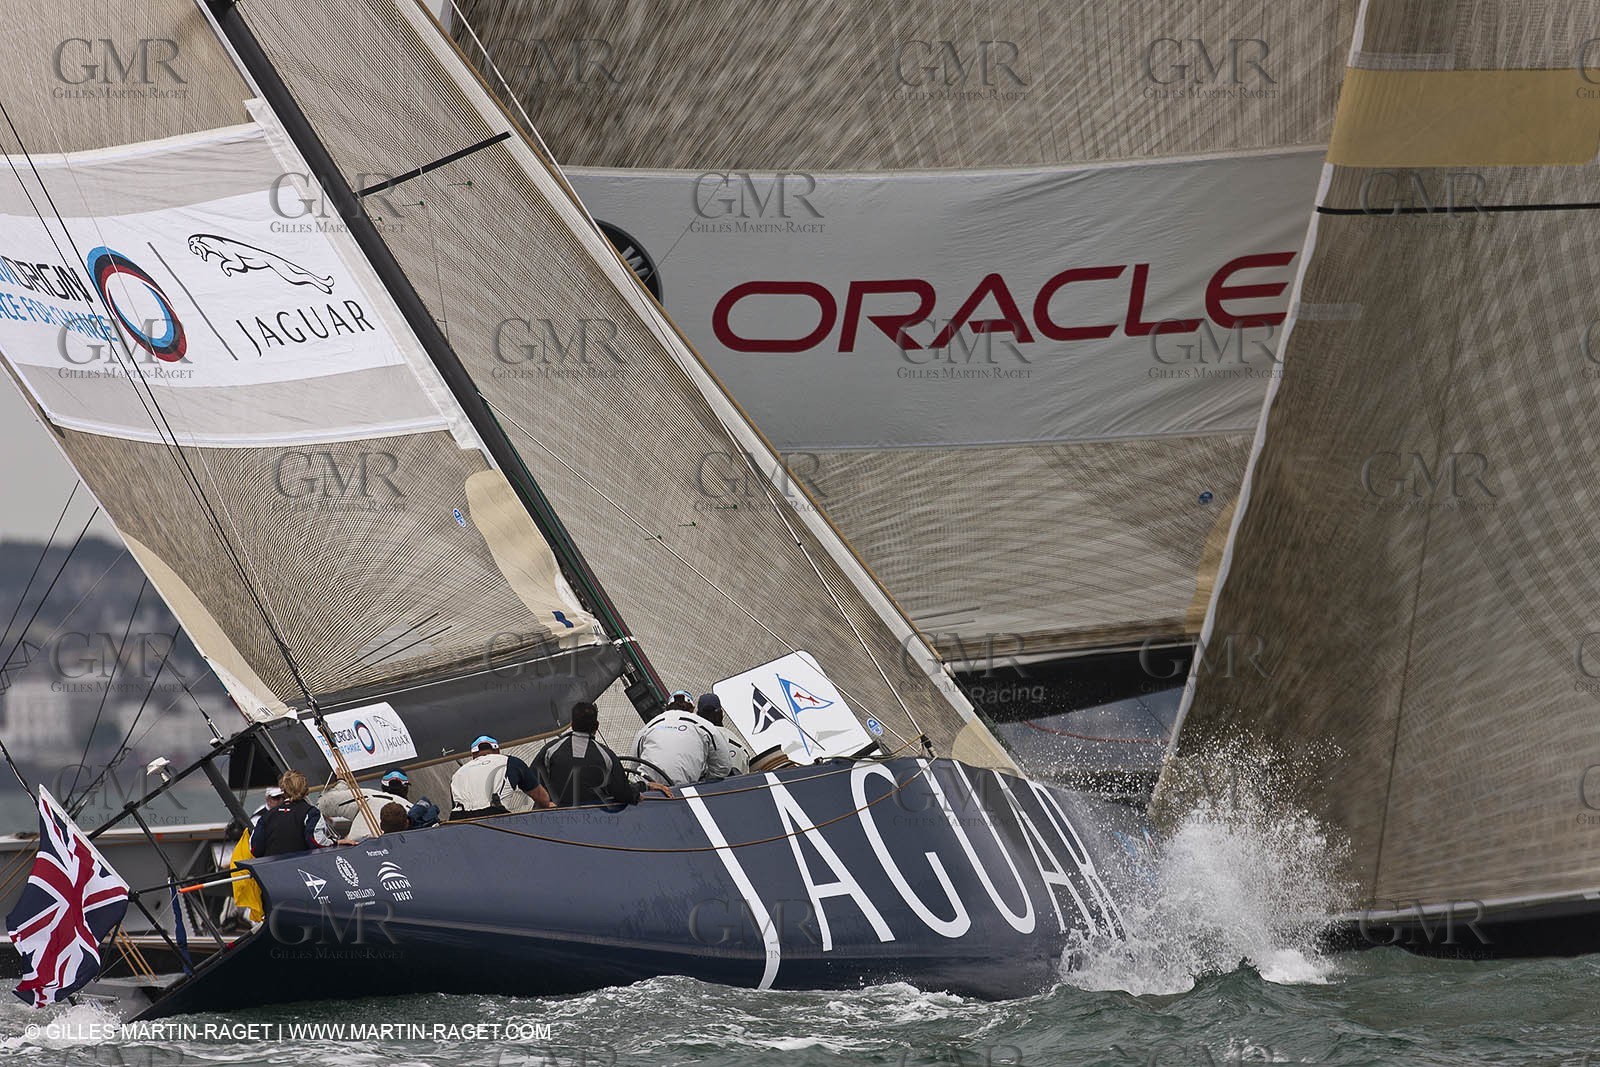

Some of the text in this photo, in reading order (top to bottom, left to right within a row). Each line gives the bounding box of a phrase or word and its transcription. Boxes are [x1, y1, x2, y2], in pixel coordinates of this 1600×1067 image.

[236, 300, 375, 357] JAGUAR
[712, 251, 1297, 353] ORACLE
[971, 684, 1045, 704] Racing
[680, 758, 1128, 989] JAGUAR
